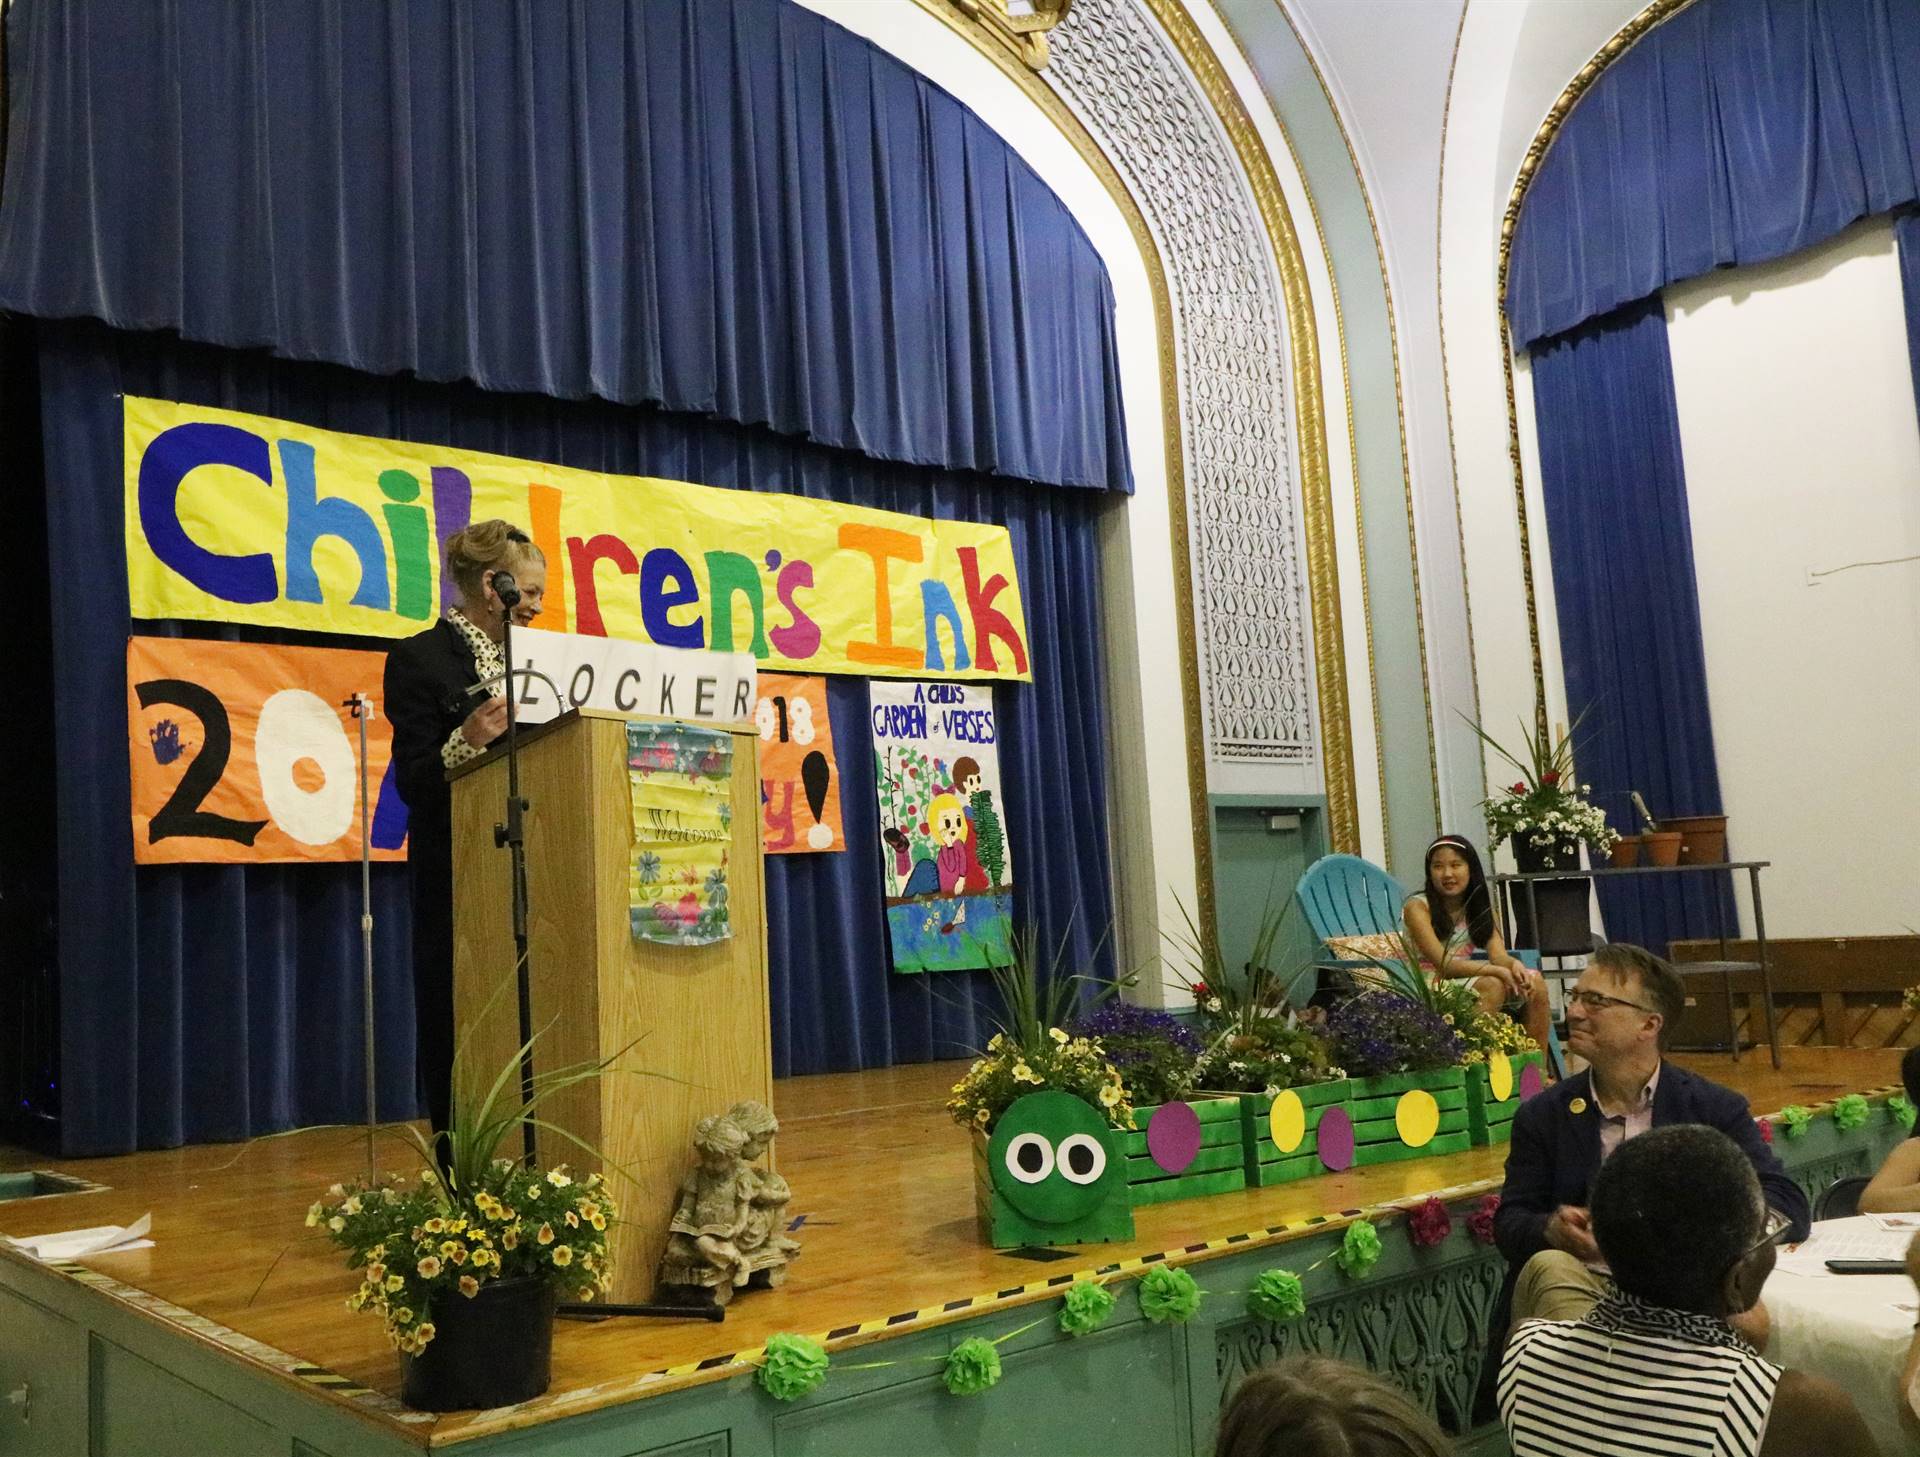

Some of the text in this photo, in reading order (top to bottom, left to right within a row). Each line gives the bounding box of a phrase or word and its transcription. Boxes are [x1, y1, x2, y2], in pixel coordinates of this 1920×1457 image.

[838, 523, 1028, 675] Ink
[519, 658, 750, 718] LOCKER
[914, 683, 925, 704] A
[873, 704, 928, 739] GARDEN
[942, 709, 995, 744] VERSES
[648, 809, 724, 842] Welcome
